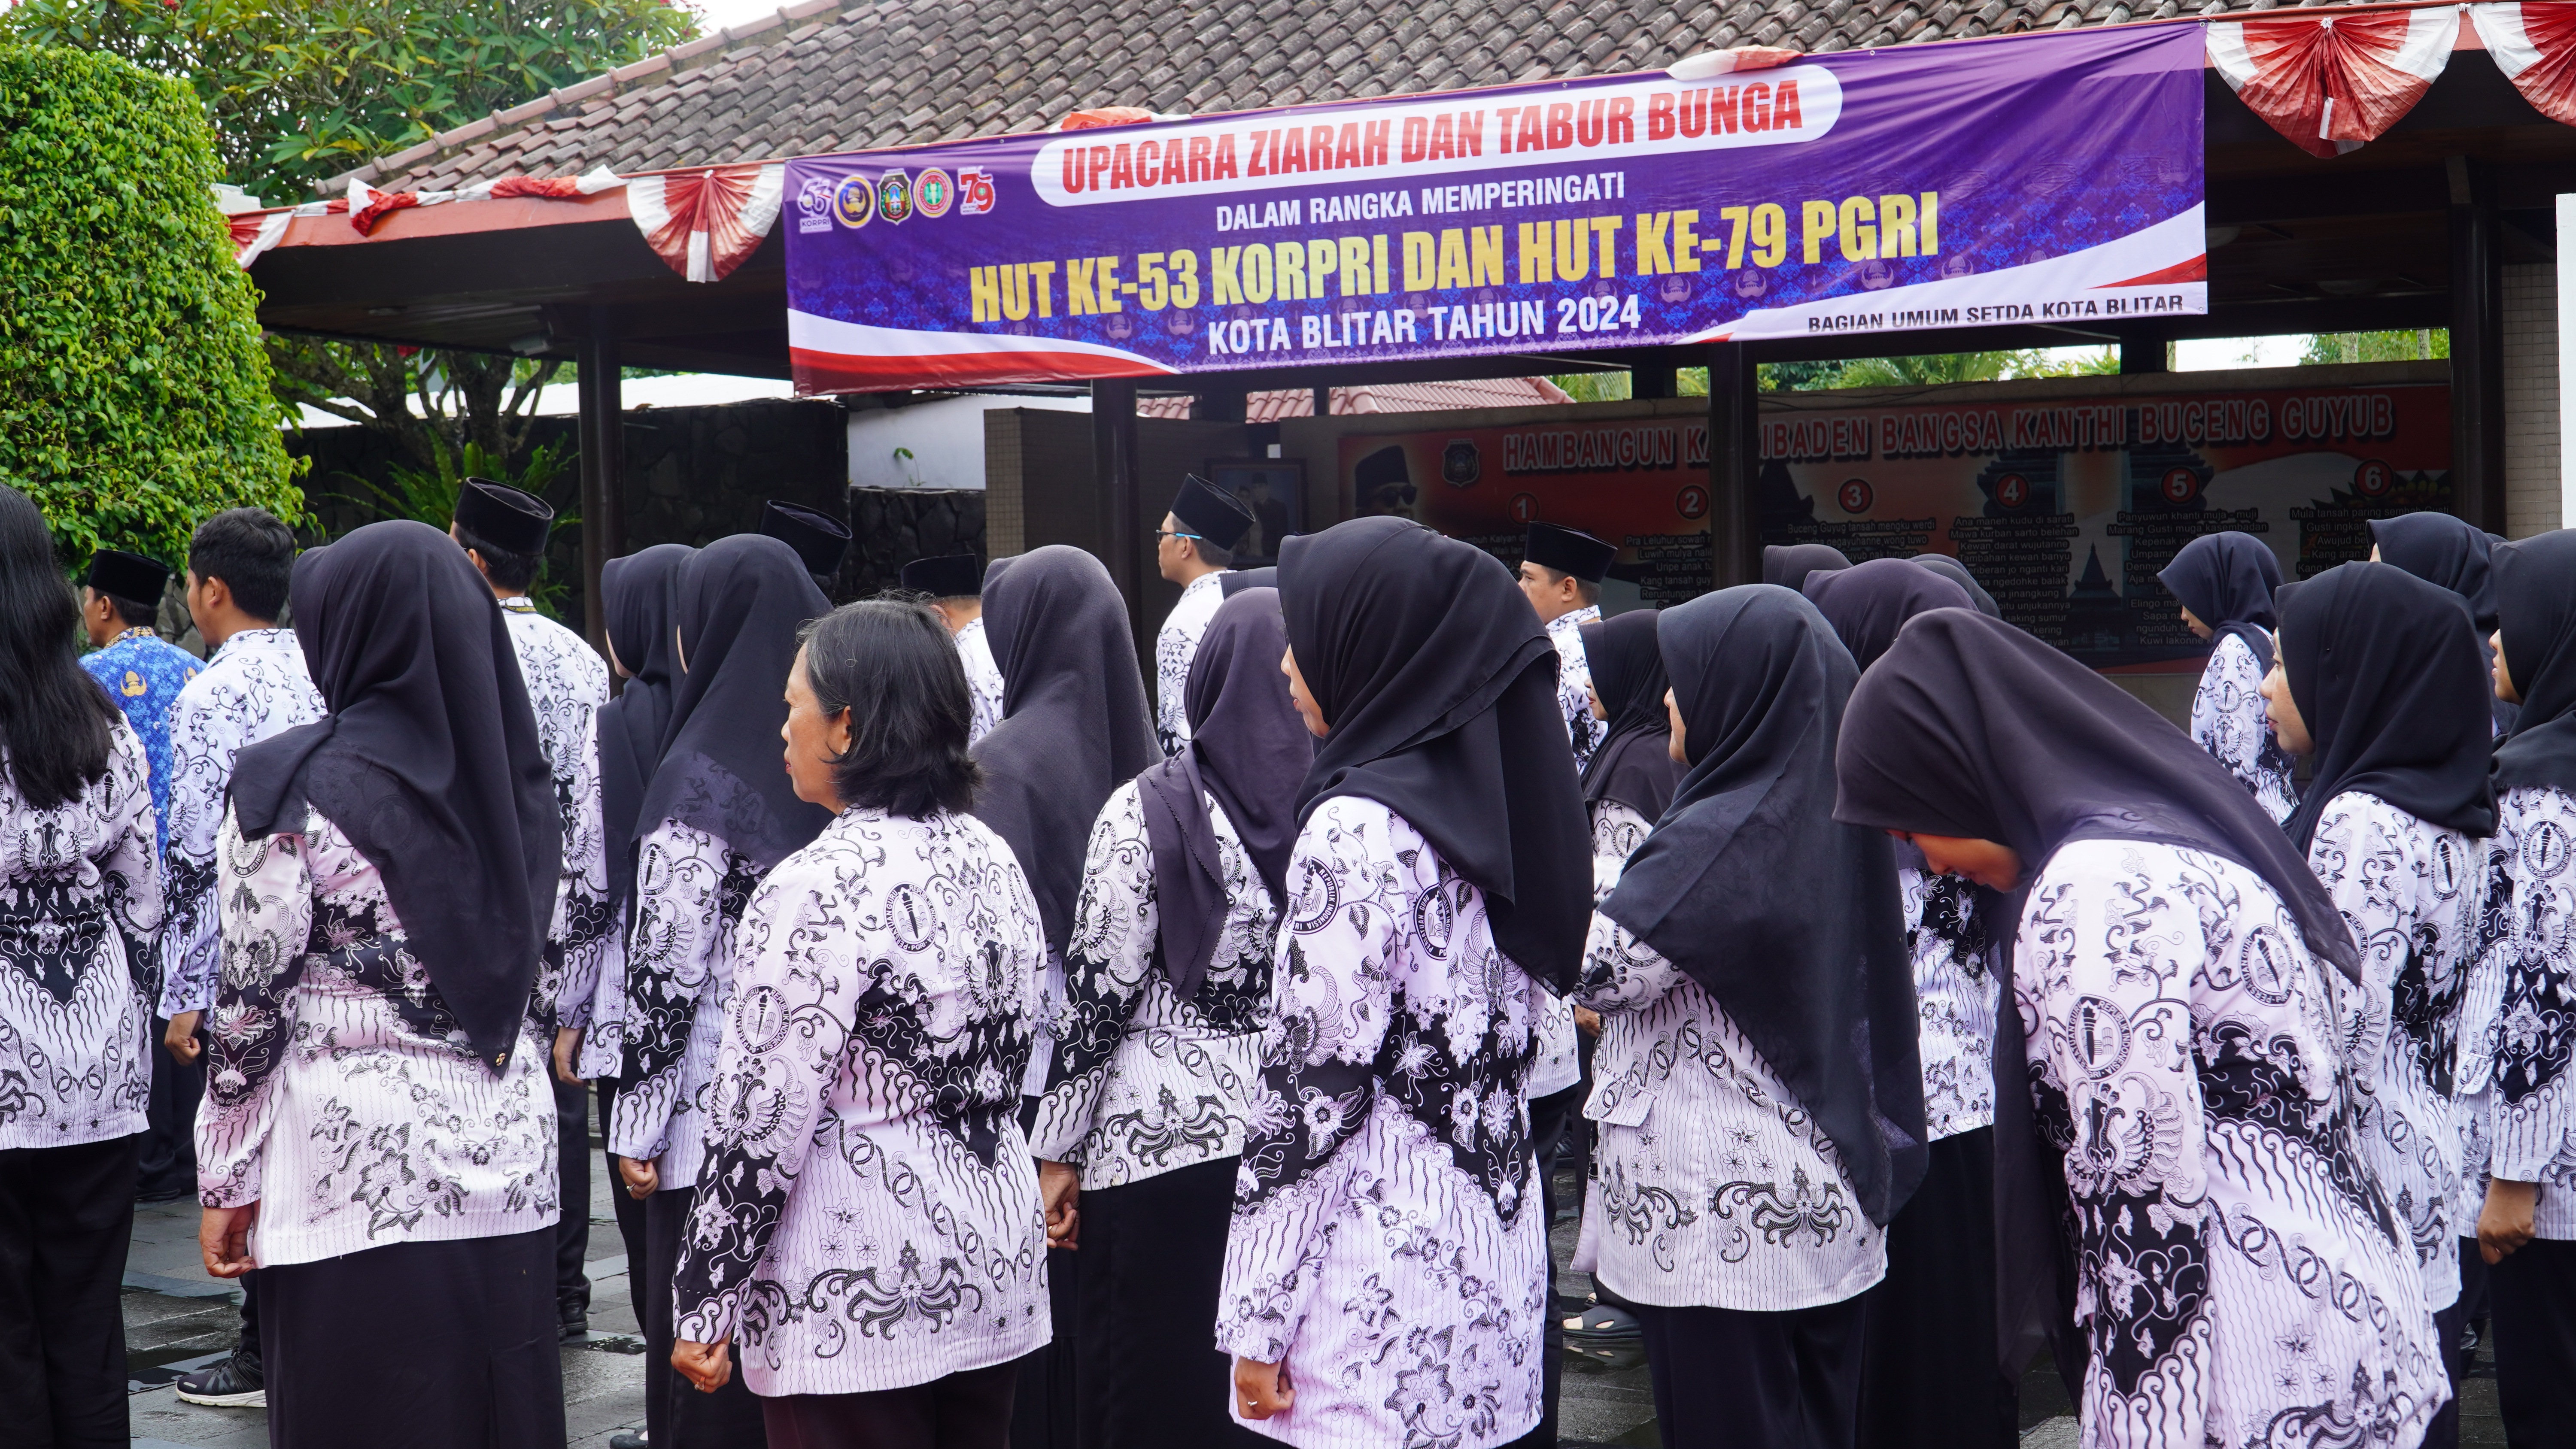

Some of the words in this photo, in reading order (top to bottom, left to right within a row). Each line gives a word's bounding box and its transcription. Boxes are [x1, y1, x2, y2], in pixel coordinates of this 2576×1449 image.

[1063, 133, 1239, 193] UPACARA
[1248, 119, 1391, 177] ZIARAH
[1401, 109, 1486, 164] DAN
[1496, 96, 1635, 154] TABUR
[1648, 79, 1804, 141] BUNGA
[1216, 199, 1301, 232] DALAM
[1310, 189, 1413, 223] RANGKA
[1422, 171, 1625, 215] MEMPERINGATI
[970, 261, 1056, 323] HUT
[1067, 249, 1200, 316] KE-53
[1211, 234, 1389, 306] KORPRI
[1402, 224, 1504, 292] DAN
[1518, 215, 1622, 284] HUT
[1636, 203, 1787, 276] KE-79
[1803, 191, 1939, 263] PGRI
[1808, 312, 1883, 333] BAGIAN
[1892, 308, 1959, 328] UMUM
[1967, 304, 2032, 324] SETDA
[2042, 300, 2096, 319] KOTA
[2106, 295, 2183, 314] BLITAR
[1208, 317, 1292, 355] KOTA
[1302, 308, 1417, 349] BLITAR
[1428, 300, 1545, 341] TAHUN
[1557, 294, 1641, 333] 2024
[1504, 427, 1674, 471] HAMBANGUN
[1880, 410, 2002, 454] BANGSA
[2012, 405, 2126, 448] KANTHI
[2138, 399, 2270, 444] BUCENG
[2281, 394, 2393, 440] GUYUB
[2366, 467, 2382, 489] 6
[2003, 479, 2019, 501] 4
[2171, 473, 2187, 497] 5
[1847, 485, 1862, 506] 3
[1685, 492, 1699, 512] 2
[1517, 499, 1527, 518] 1
[2292, 509, 2314, 518] Mula
[2318, 508, 2349, 518] tansah
[2352, 507, 2382, 520] paring
[1955, 518, 1973, 527] Ana
[1976, 516, 2007, 525] maneh
[2010, 516, 2033, 525] kudu
[2035, 515, 2044, 524] di
[2047, 515, 2073, 524] sarati
[2118, 512, 2168, 523] Panyuwun
[2171, 511, 2200, 521] khanti
[2203, 511, 2227, 522] muja
[2236, 509, 2257, 521] muji
[1788, 524, 1817, 534] Buceng
[1849, 520, 1876, 532] tansah
[1878, 520, 1910, 532] mengku
[1912, 518, 1935, 530] werdi
[2108, 525, 2144, 537] Marang
[2148, 524, 2172, 534] Gusti
[2176, 524, 2202, 535] muga
[2205, 522, 2267, 532] kasembadan
[2306, 522, 2330, 532] Gusti
[1950, 530, 1978, 539] Mawa
[1981, 529, 2011, 538] kurban
[2014, 528, 2038, 537] sarto
[2041, 527, 2078, 537] belehan
[1626, 536, 1641, 546] Pra
[1908, 535, 1928, 544] tuwo
[2021, 540, 2069, 551] wujutanne
[2135, 537, 2176, 548] Kepenak
[2317, 535, 2351, 546] Awujud
[1639, 548, 1664, 558] Luwih
[1667, 548, 1692, 559] mulya
[1959, 553, 2006, 563] Tambahan
[2009, 552, 2039, 561] kewan
[2042, 552, 2070, 562] banyu
[2131, 549, 2174, 559] Umpama
[2312, 549, 2336, 560] Kang
[2339, 550, 2360, 558] aran
[1656, 561, 1679, 572] Uripe
[1682, 561, 1702, 570] anak
[2008, 566, 2017, 576] jo
[2020, 565, 2048, 576] nganti
[2051, 564, 2068, 573] kari
[2126, 562, 2162, 573] Dennya
[2298, 564, 2322, 574] Kang
[1640, 576, 1662, 586] Kang
[1665, 575, 1693, 585] tansah
[1993, 577, 2038, 587] ngedohke
[2041, 576, 2067, 585] balak
[2129, 574, 2144, 584] Aja
[1641, 588, 1696, 600] Reruntungan
[2008, 589, 2059, 600] jinangkung
[2017, 601, 2071, 611] unjukannya
[2131, 598, 2160, 609] Elingo
[2005, 613, 2035, 623] saking
[2143, 611, 2168, 621] Sapa
[2034, 625, 2062, 635] kering
[2136, 624, 2178, 634] ngunduh
[2140, 636, 2163, 645] Kuwi
[2166, 636, 2204, 645] lakonne
[1319, 868, 1336, 903] REPUBLIK
[1419, 894, 1430, 911] GURU
[1306, 903, 1335, 930] INDONESIA
[2348, 915, 2368, 946] REPUBLIK
[771, 989, 790, 1021] REPUBLIK
[2097, 1000, 2129, 1032] REPUBLIK
[760, 1022, 790, 1052] INDONESIA
[2105, 1034, 2130, 1074] INDONESIA
